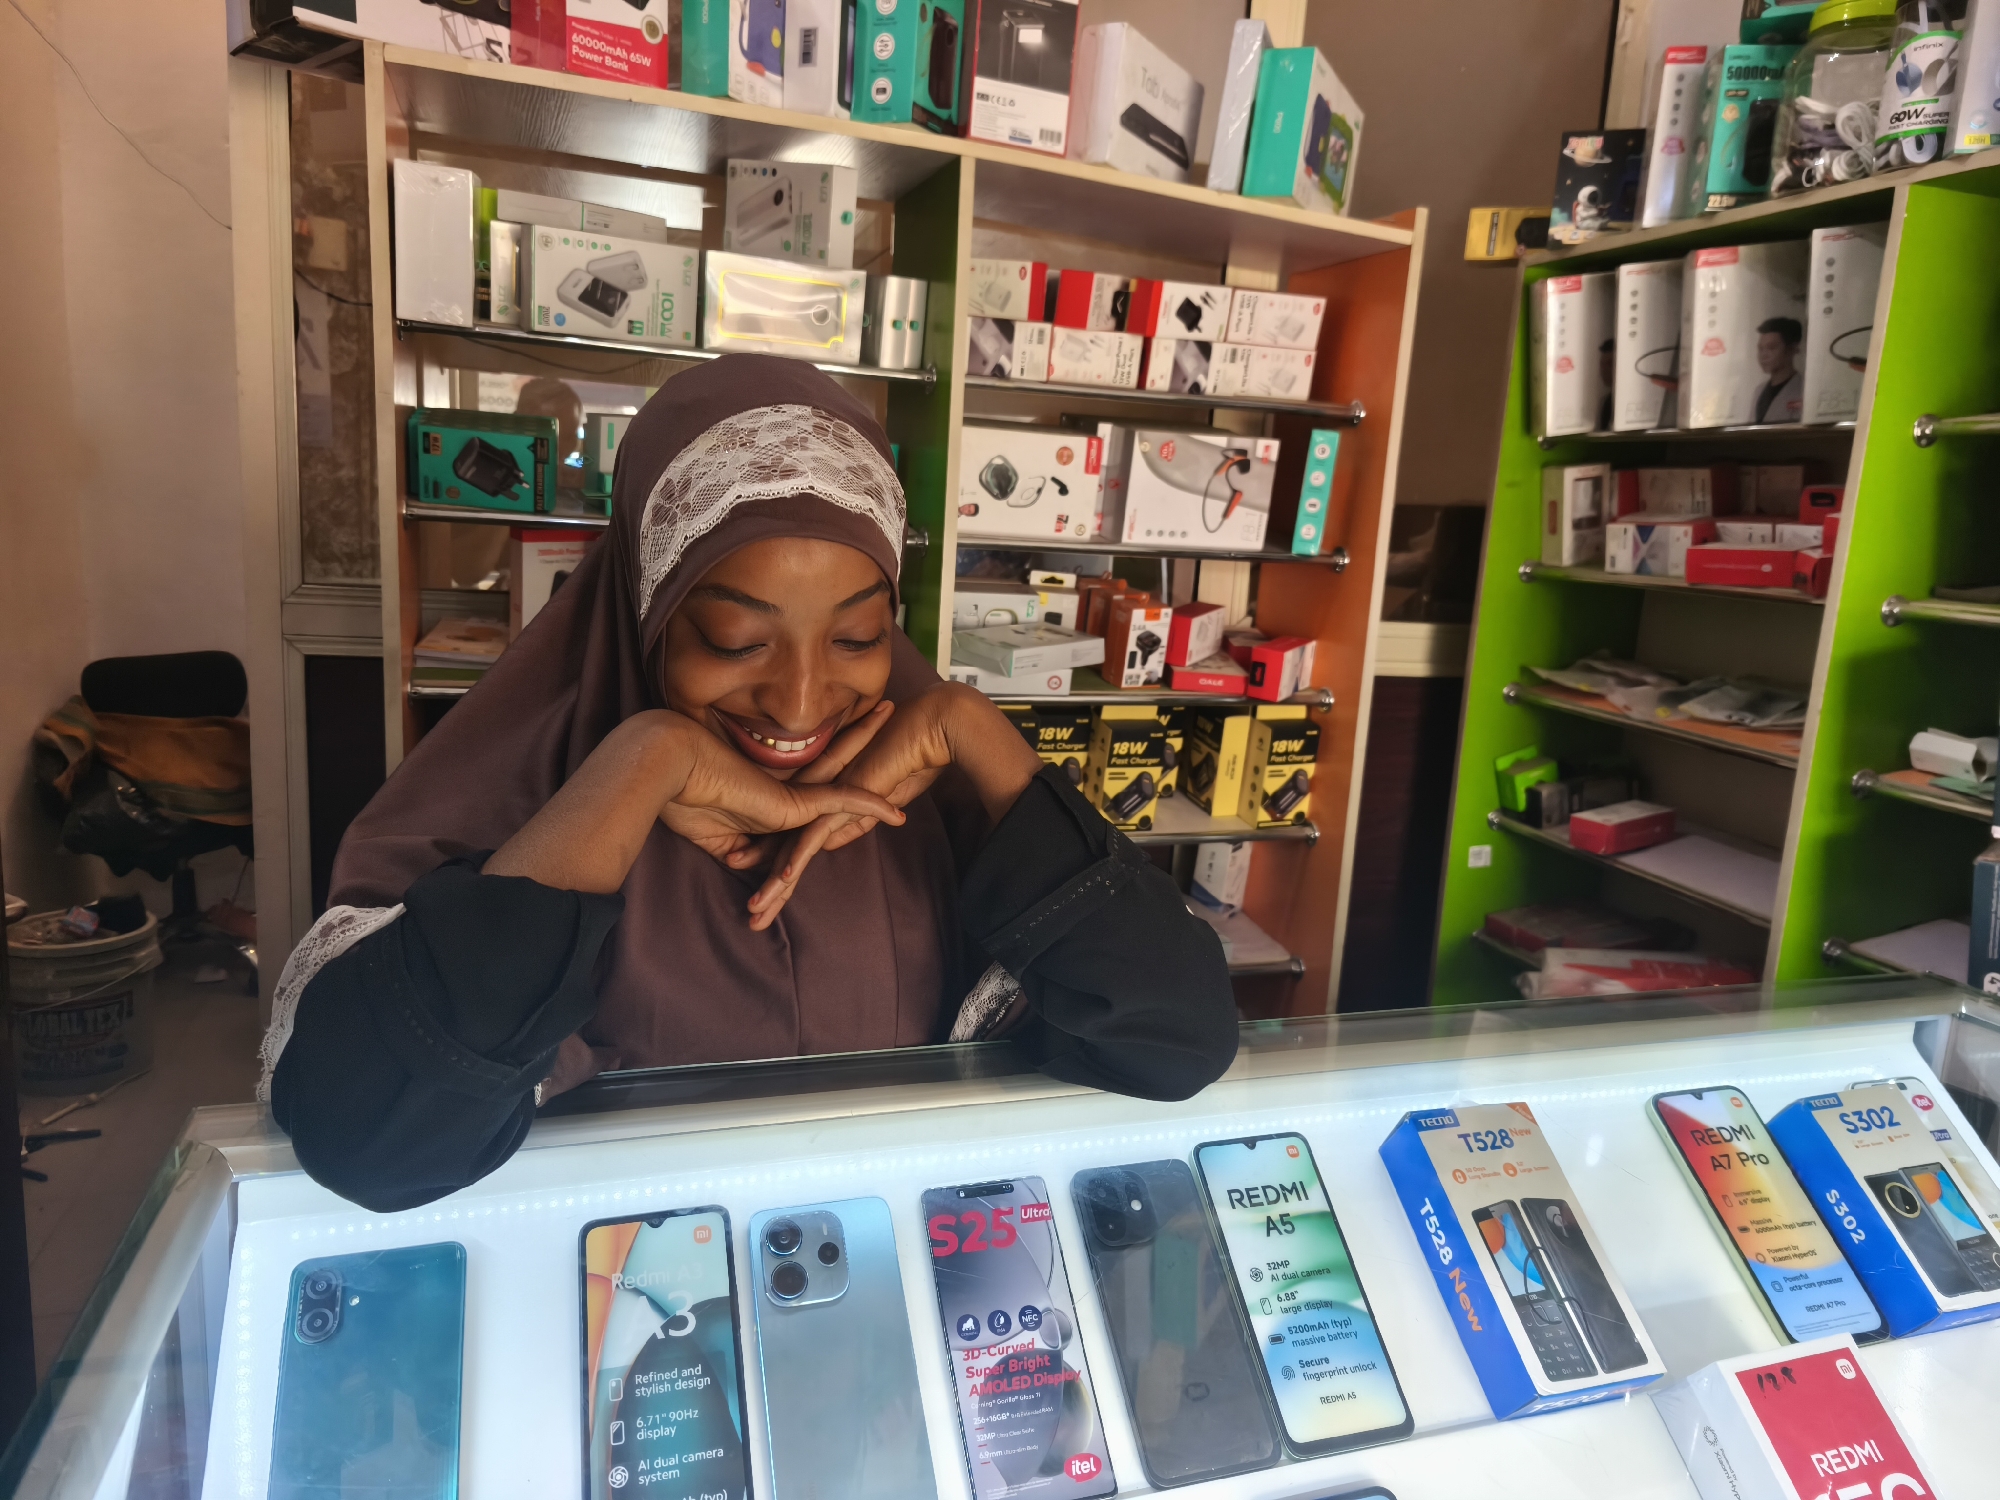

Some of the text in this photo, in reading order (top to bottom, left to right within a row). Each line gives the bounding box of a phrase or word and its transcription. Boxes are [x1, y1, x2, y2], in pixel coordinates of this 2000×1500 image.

[571, 32, 628, 60] 60000mAh
[629, 52, 652, 67] 65W
[1913, 41, 1944, 52] infinix
[571, 44, 629, 72] Power Bank
[1889, 107, 1950, 124] 60W SUPER
[1906, 118, 1949, 128] CHARGING
[1039, 727, 1074, 740] 18W
[1056, 743, 1086, 751] Charger
[1113, 741, 1148, 755] 18W
[1272, 739, 1305, 754] 18W
[1110, 757, 1160, 765] Fast Charger
[1287, 754, 1315, 762] Charger
[1808, 1096, 1838, 1108] TECNO
[1418, 1115, 1455, 1127] TECNO
[1839, 1105, 1902, 1134] S302
[1457, 1127, 1532, 1153] T528 New
[1690, 1124, 1756, 1147] REDMI
[1710, 1151, 1770, 1172] A7 Pro
[1226, 1180, 1310, 1210] REDMI
[1265, 1213, 1296, 1237] A5
[1825, 1188, 1866, 1245] S302
[928, 1207, 1051, 1258] S25 Ultra
[1419, 1198, 1453, 1265] T528
[1766, 1245, 1791, 1255] Powered
[1771, 1254, 1793, 1263] Xiaomi
[1266, 1260, 1290, 1271] 32MP
[1270, 1266, 1332, 1283] AI dual camera
[611, 1269, 671, 1291] Redmi
[1783, 1273, 1810, 1283] Powerful
[1817, 1277, 1843, 1288] processor
[1280, 1299, 1333, 1315] large display
[1448, 1267, 1484, 1332] New
[1805, 1304, 1826, 1312] REDMI
[1021, 1314, 1039, 1323] NFC
[1287, 1316, 1352, 1335] 5200mAh (typ)
[1291, 1329, 1358, 1348] massive battery
[962, 1338, 1035, 1362] 3D-Curved
[965, 1355, 1051, 1379] Super Bright
[1298, 1356, 1330, 1369] Secure
[1302, 1360, 1378, 1382] fingerprint unlock
[635, 1363, 702, 1385] Refined and
[635, 1375, 711, 1398] stylish design
[969, 1369, 1082, 1398] AMOLED Display
[1319, 1391, 1357, 1405] REDMI A5
[636, 1408, 700, 1428] 6.71" 90Hz
[636, 1425, 677, 1441] display
[976, 1432, 996, 1442] 32MP
[638, 1448, 724, 1473] AI dual camera
[979, 1450, 1003, 1459] 6.9mm
[1026, 1444, 1039, 1452] Body
[1810, 1439, 1884, 1478] REDMI
[1071, 1457, 1096, 1476] itel
[1714, 1450, 1732, 1480] Xiaomi
[638, 1468, 680, 1486] system
[1732, 1473, 1739, 1481] by
